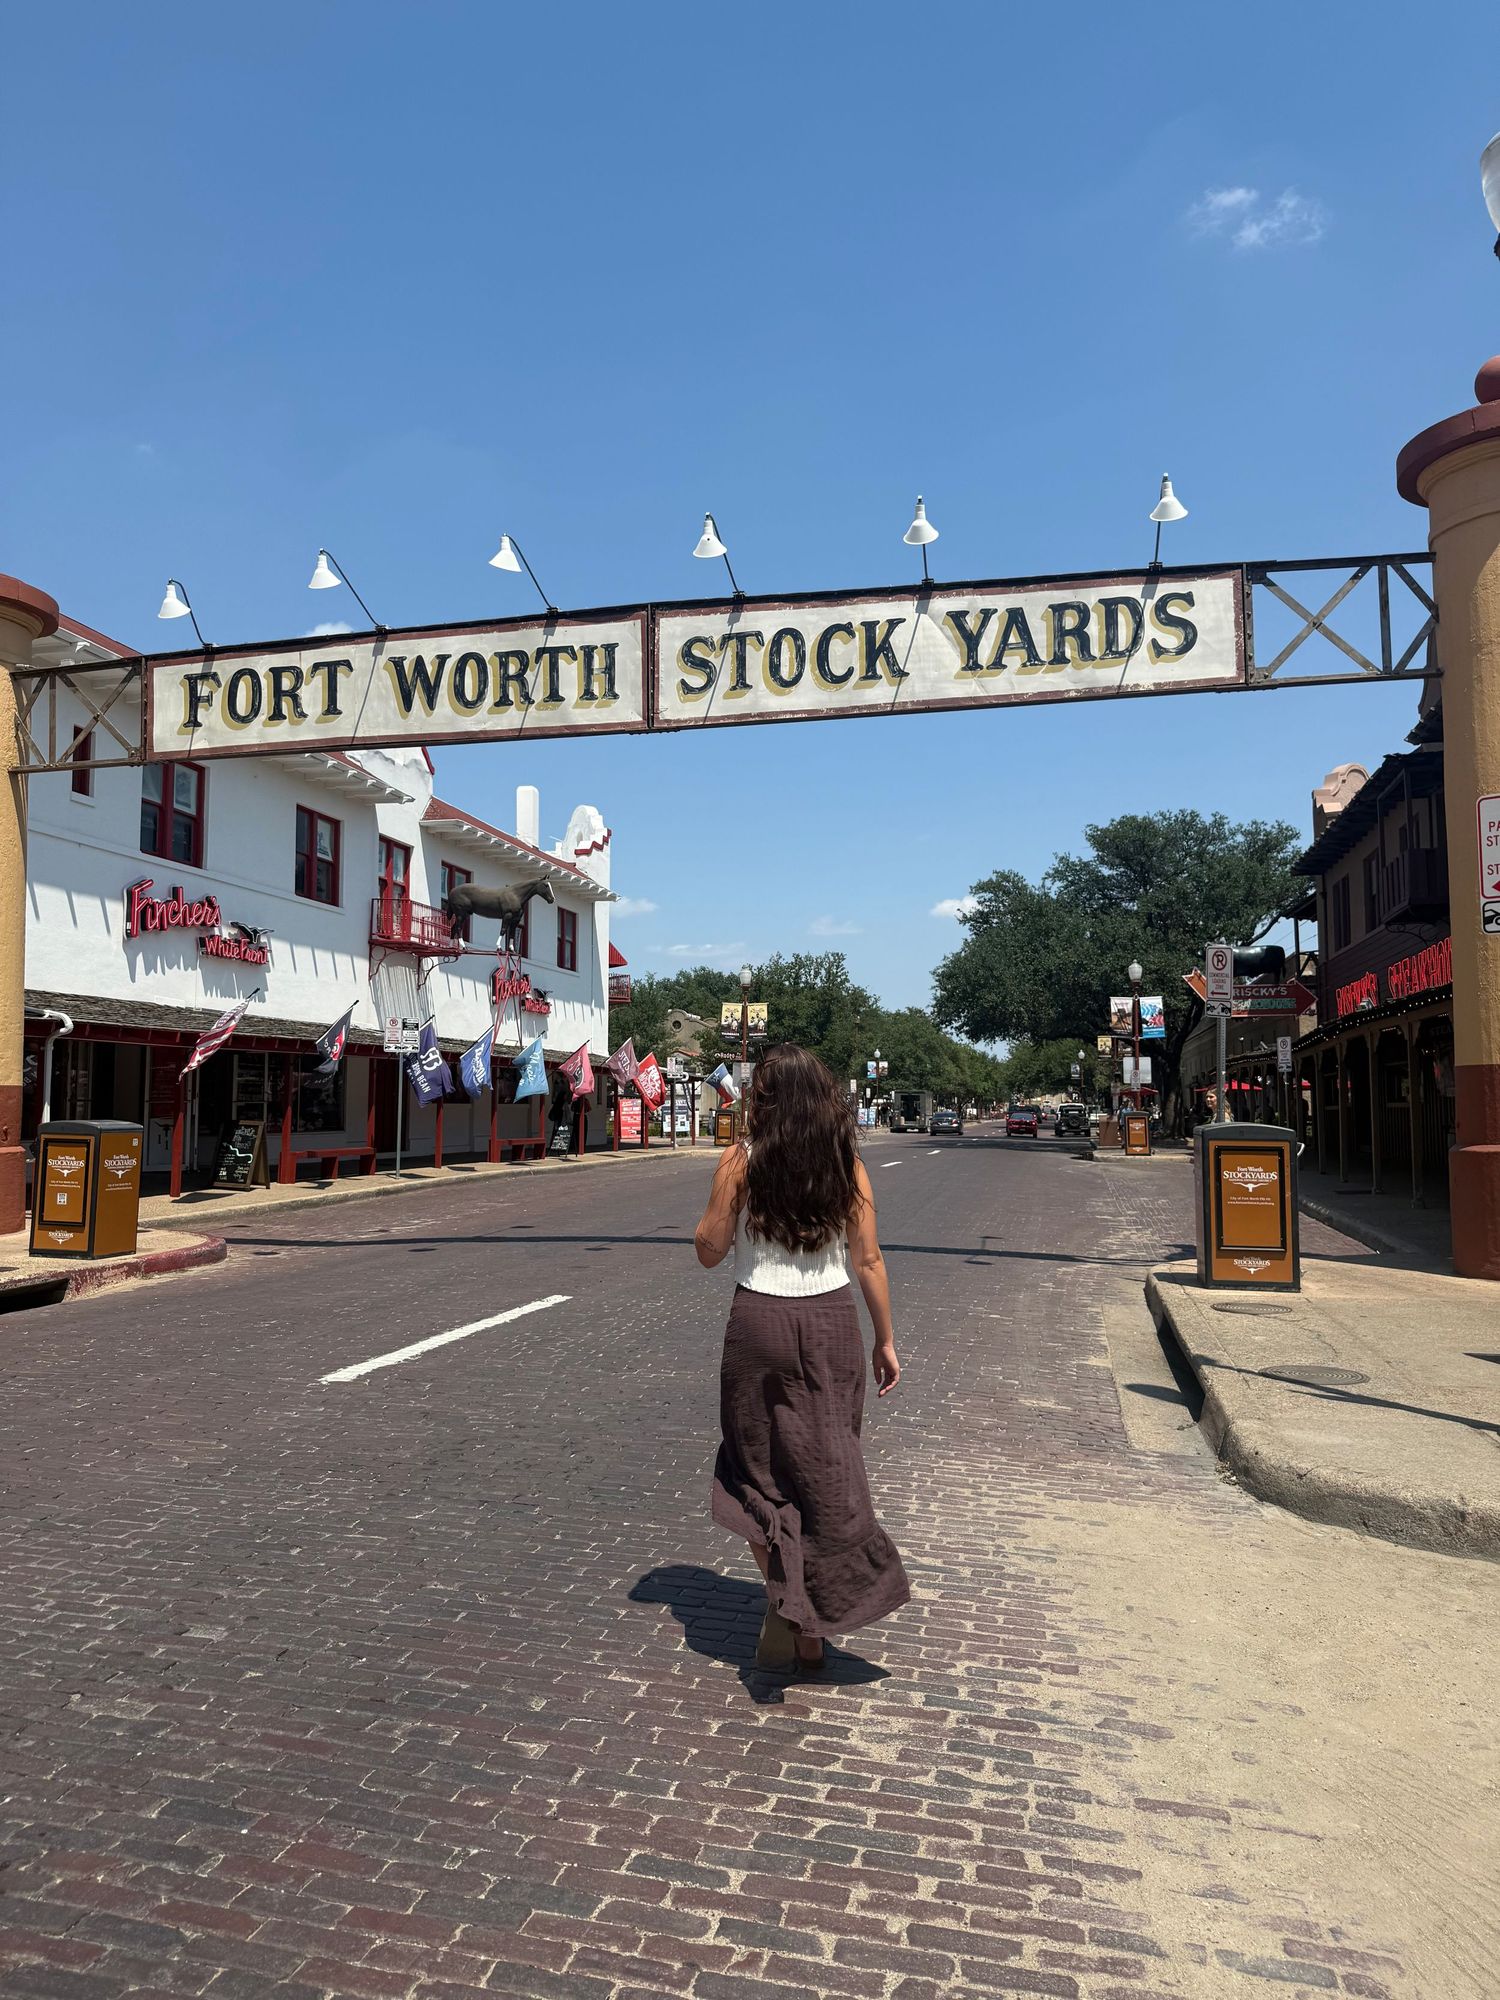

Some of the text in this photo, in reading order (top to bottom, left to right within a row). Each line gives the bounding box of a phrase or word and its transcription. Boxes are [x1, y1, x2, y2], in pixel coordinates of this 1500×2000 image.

[180, 592, 1199, 731] FORT WORTH STOCK YARDS
[130, 879, 222, 938] Fincher's
[1233, 986, 1288, 997] RISCKY'S
[416, 1074, 432, 1093] BEAN
[48, 1159, 85, 1167] STOCKYARDS
[104, 1158, 137, 1167] STOCKYARDS
[1223, 1170, 1278, 1180] STOCKYARDS
[1233, 1258, 1271, 1267] STOCKYARDS
